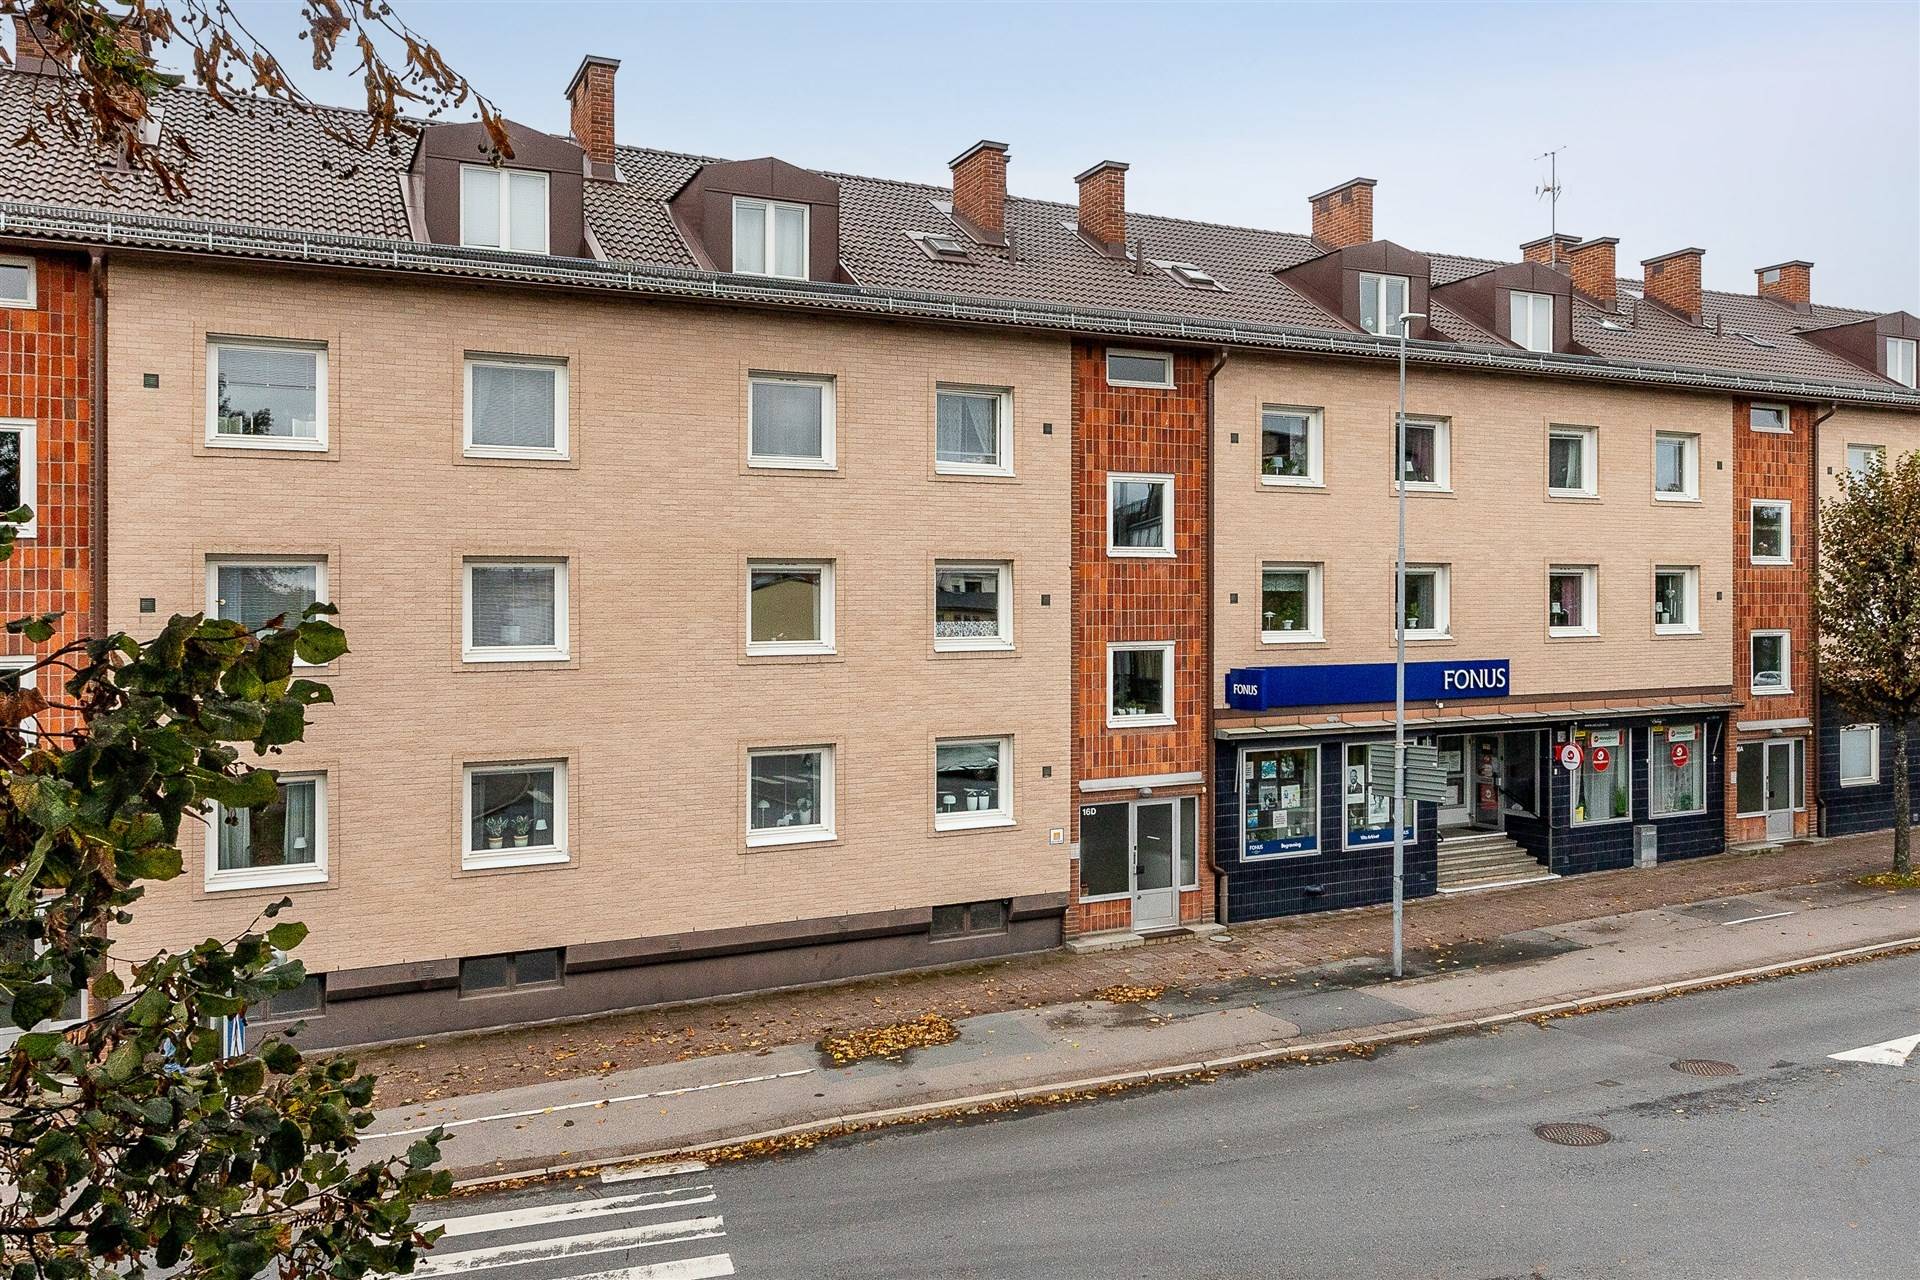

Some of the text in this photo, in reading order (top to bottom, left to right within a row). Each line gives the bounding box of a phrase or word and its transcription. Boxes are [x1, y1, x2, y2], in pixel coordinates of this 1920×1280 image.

[1444, 668, 1506, 690] FONUS
[1233, 684, 1258, 695] FONUS
[1082, 807, 1097, 816] 16D
